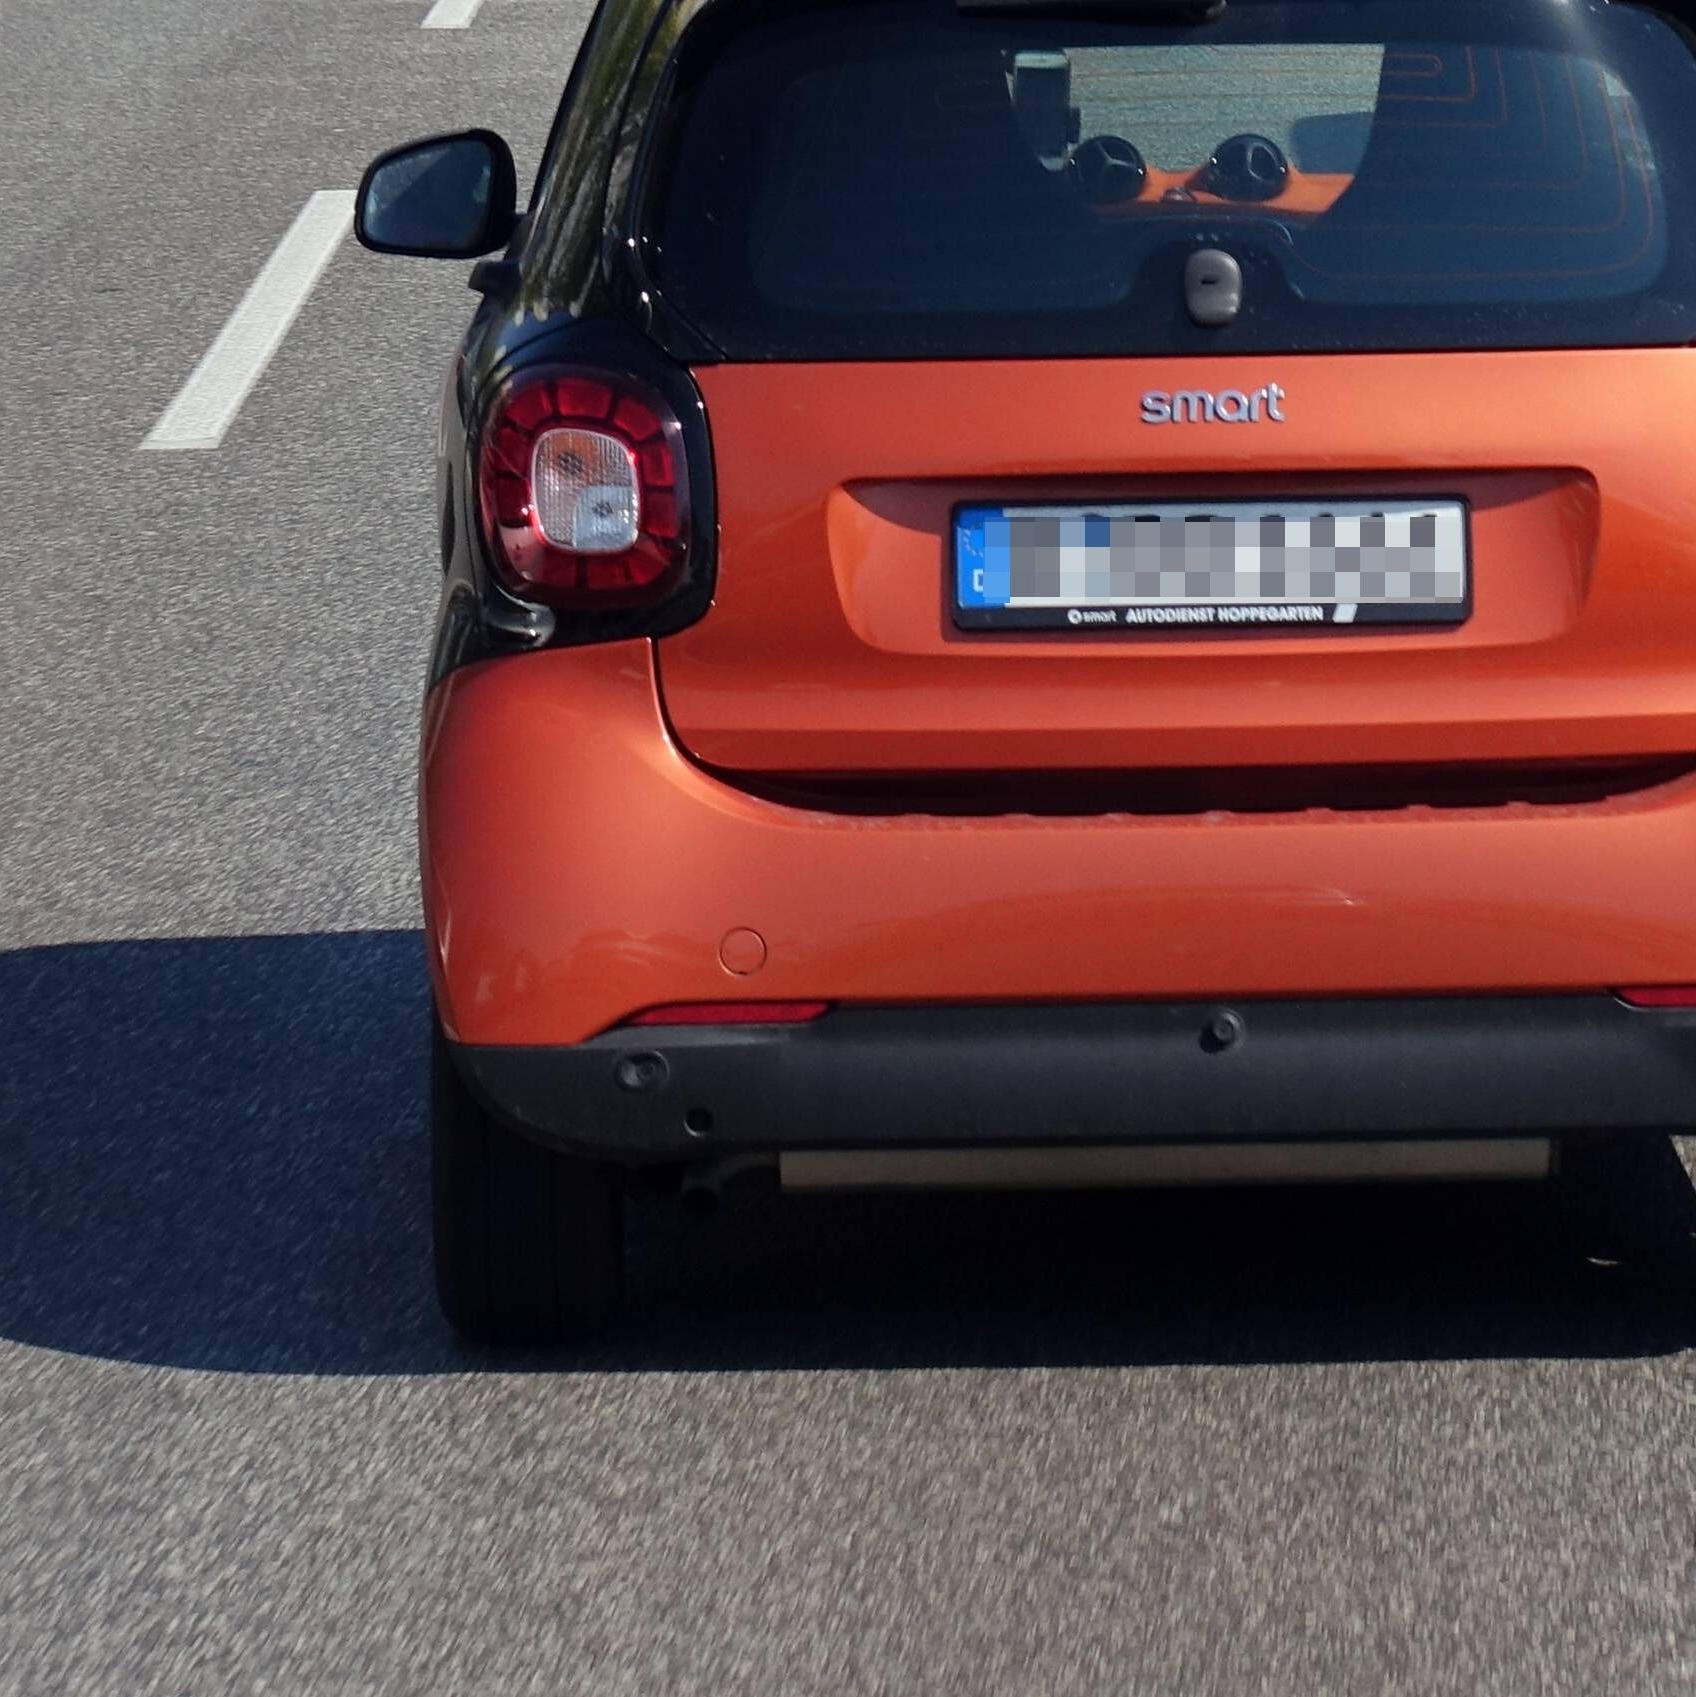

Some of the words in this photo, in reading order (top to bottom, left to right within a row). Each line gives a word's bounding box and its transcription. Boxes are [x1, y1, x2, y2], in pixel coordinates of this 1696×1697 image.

[1141, 382, 1285, 423] smart
[1081, 610, 1117, 623] smart
[1125, 607, 1216, 624] AUTODIENST
[1217, 606, 1324, 623] HOPPEGARTEN
